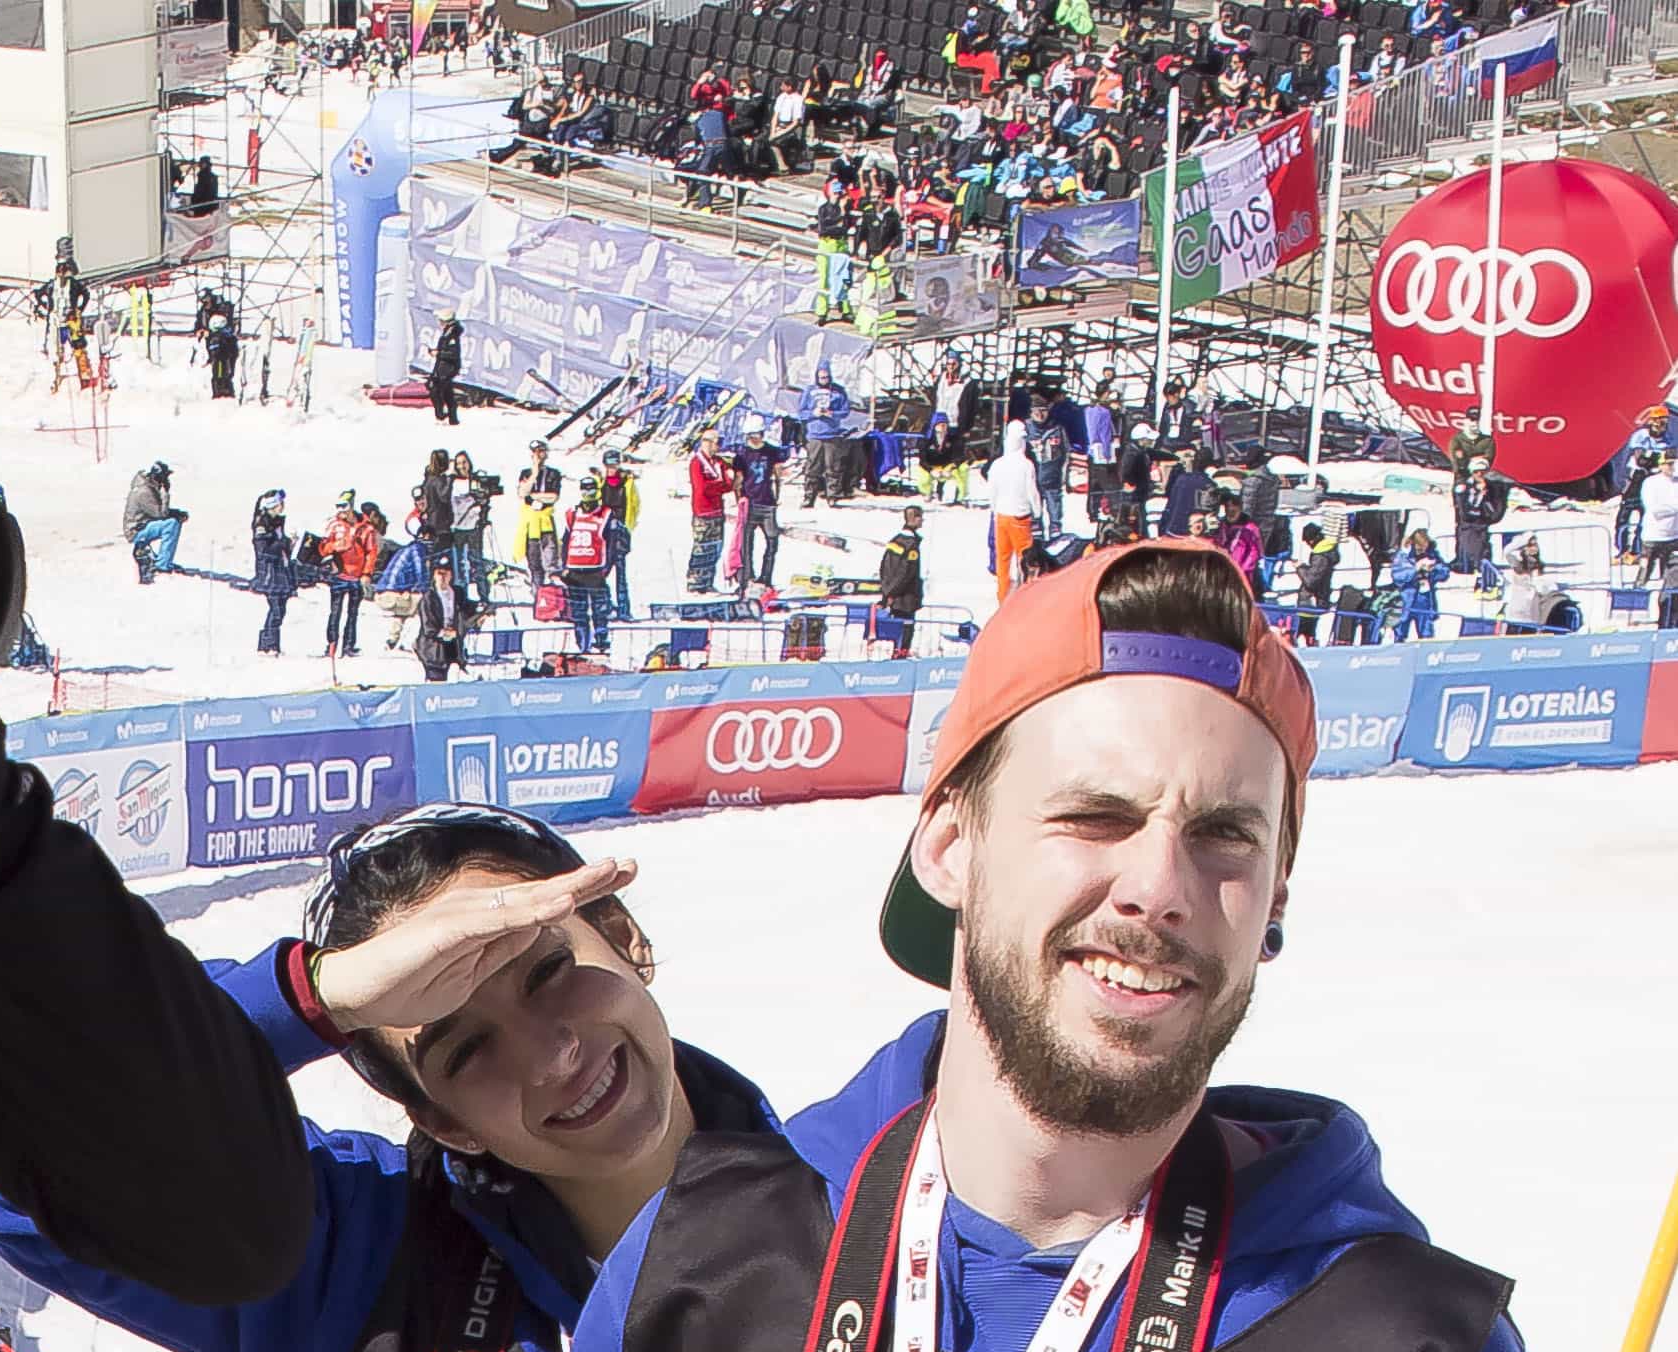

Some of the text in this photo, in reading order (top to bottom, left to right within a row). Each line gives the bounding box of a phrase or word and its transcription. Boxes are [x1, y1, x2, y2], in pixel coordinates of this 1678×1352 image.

[1173, 196, 1271, 279] Gaas
[1241, 211, 1313, 278] Mando
[1406, 404, 1566, 433] quatro
[1495, 684, 1617, 720] LOTERÍAS
[1317, 712, 1399, 751] istar
[503, 734, 620, 774] LOTERÍAS
[205, 742, 393, 825] honor
[707, 786, 762, 806] Audi
[206, 821, 317, 862] FOR THE BRAVE
[1161, 1231, 1203, 1308] Mark
[464, 1247, 504, 1339] DIGIT
